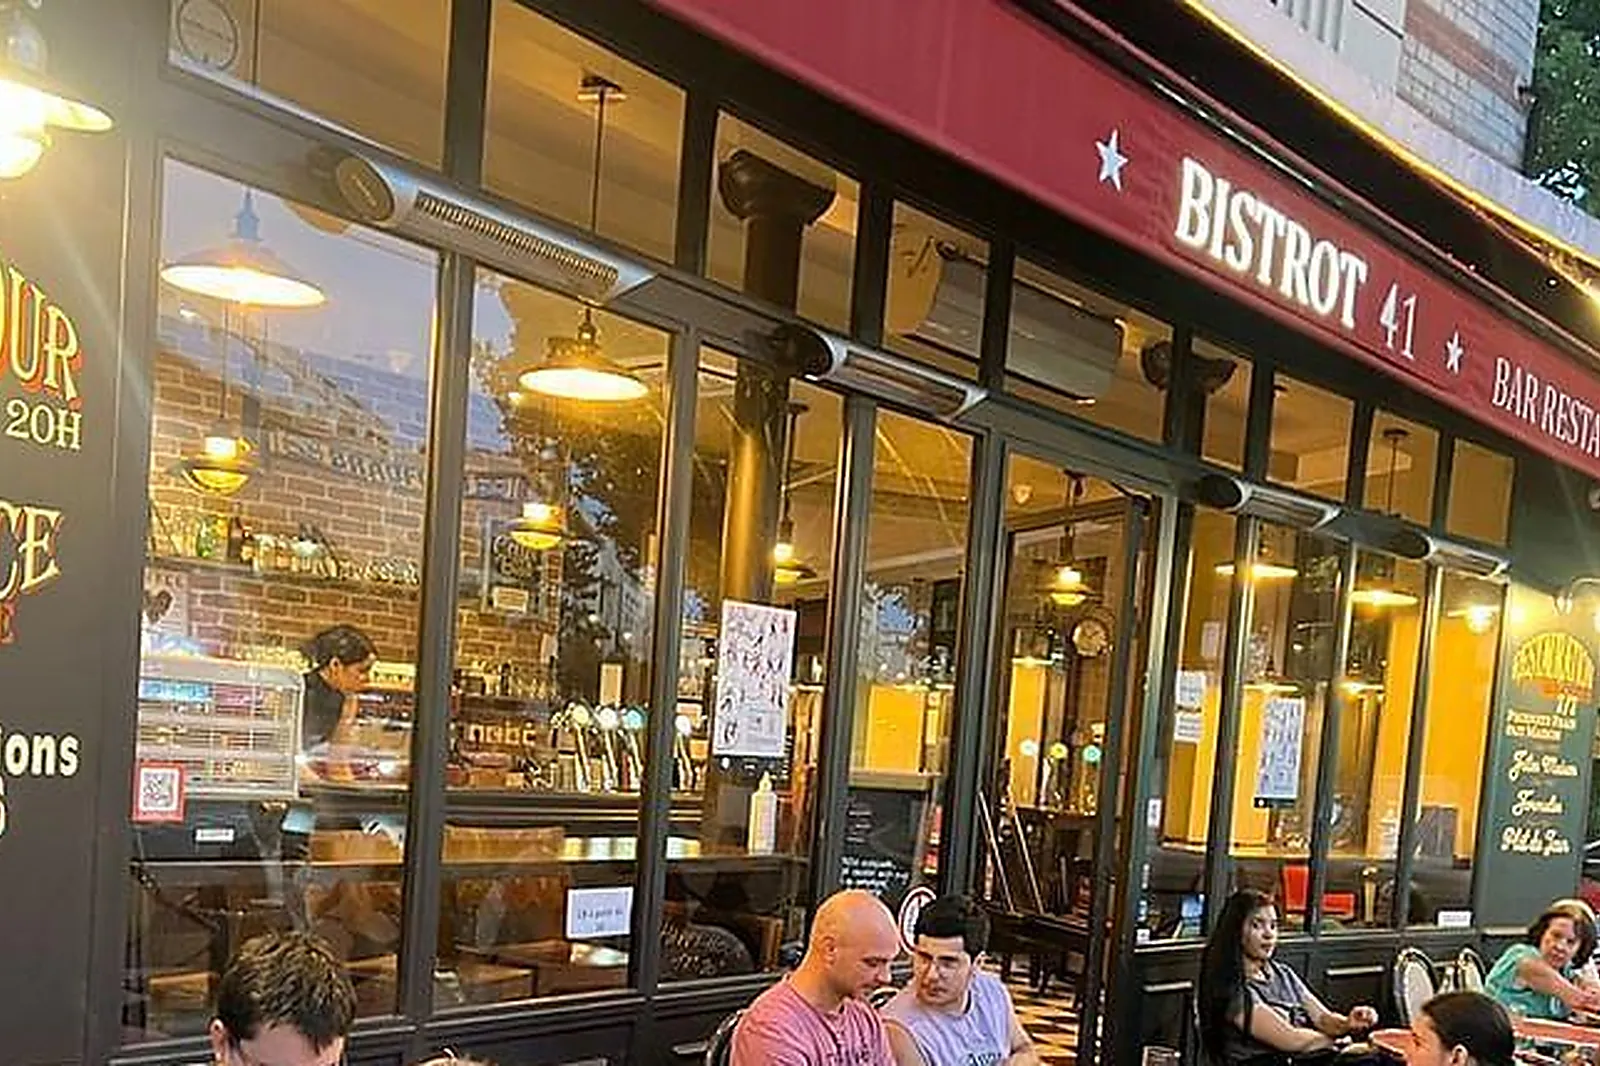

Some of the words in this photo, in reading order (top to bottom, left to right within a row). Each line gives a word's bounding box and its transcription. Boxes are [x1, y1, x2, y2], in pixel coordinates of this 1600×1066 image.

[1174, 156, 1368, 329] BISTROT
[1380, 283, 1417, 359] 41
[0, 258, 80, 402] UR
[5, 399, 82, 450] 20H
[1492, 357, 1536, 424] BAR
[1541, 384, 1600, 458] RESTA
[0, 723, 79, 776] ons
